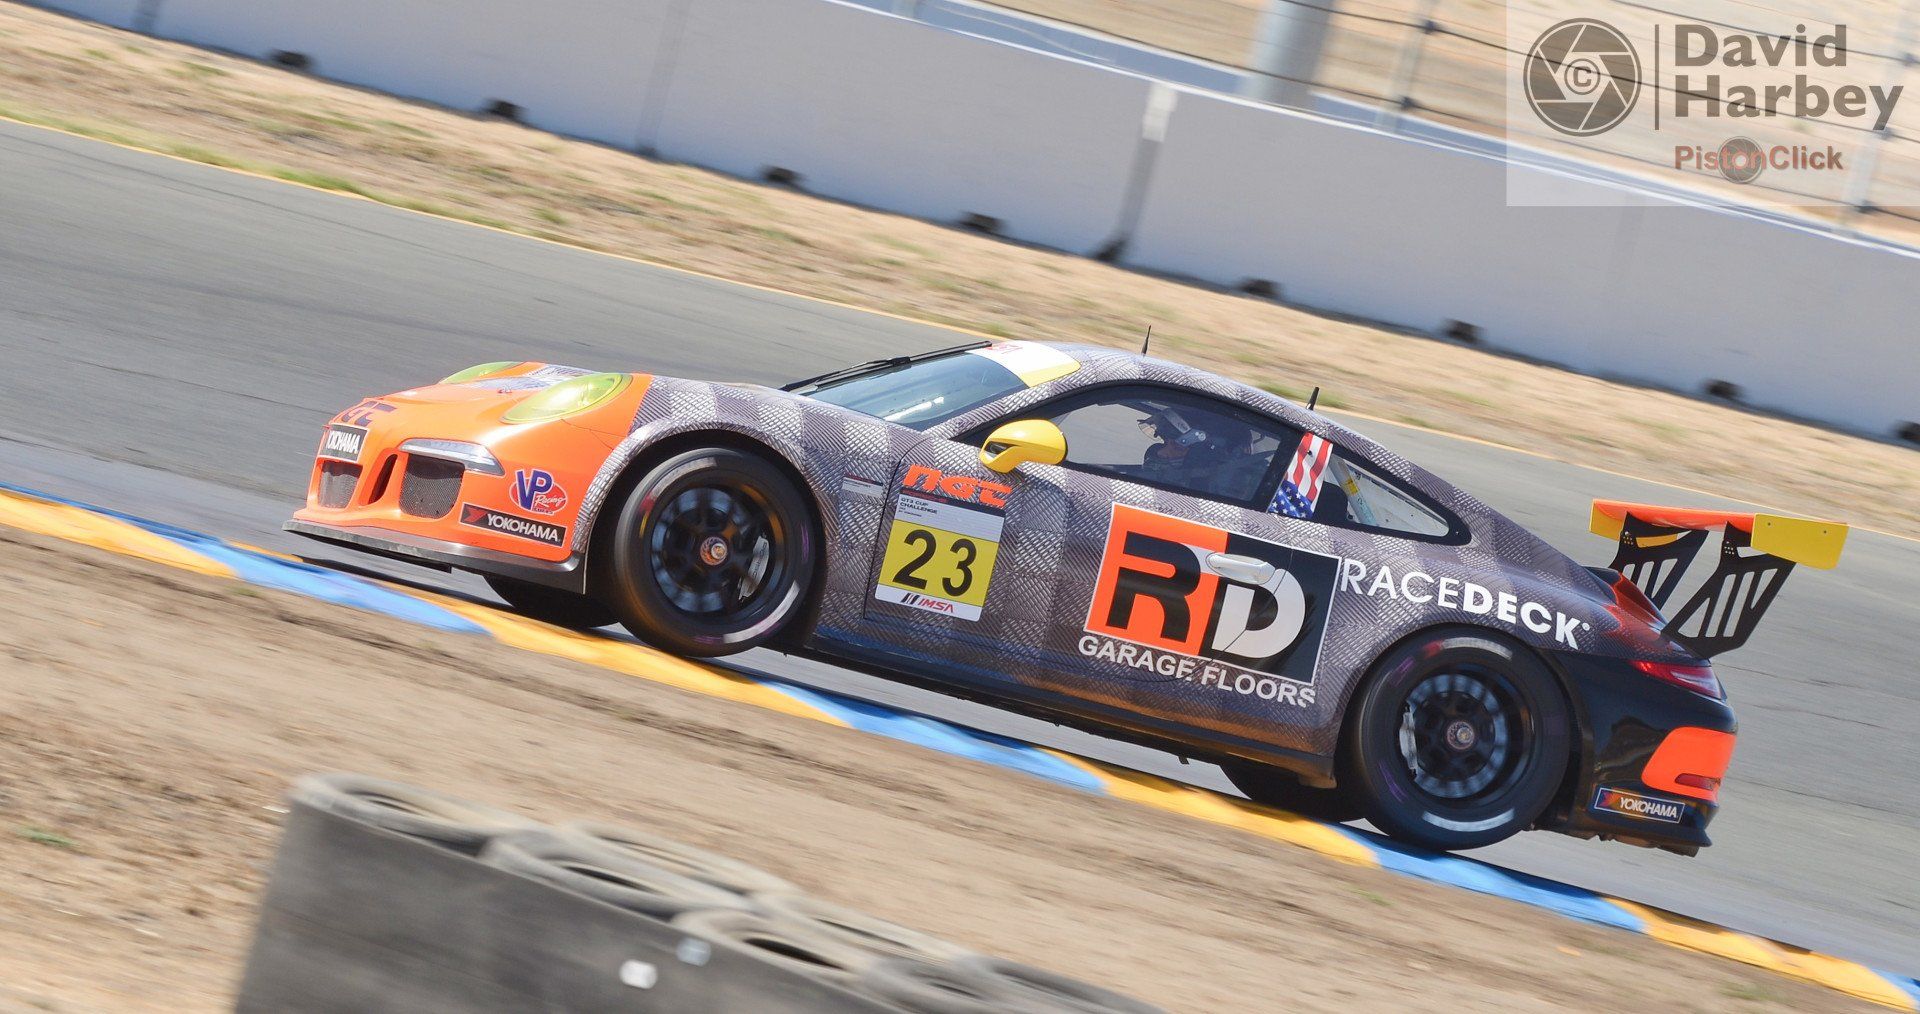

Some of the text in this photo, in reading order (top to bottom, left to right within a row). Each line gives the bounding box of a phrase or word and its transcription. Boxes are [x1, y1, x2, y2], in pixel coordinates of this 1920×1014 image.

[515, 468, 553, 512] VP
[899, 502, 938, 515] CHALLENGE
[487, 513, 558, 542] YOKOHAMA
[892, 529, 977, 597] 23
[918, 598, 954, 614] IMSA
[1078, 635, 1316, 708] GARAGE FLOORS
[1620, 797, 1677, 818] YOKOHAMA
